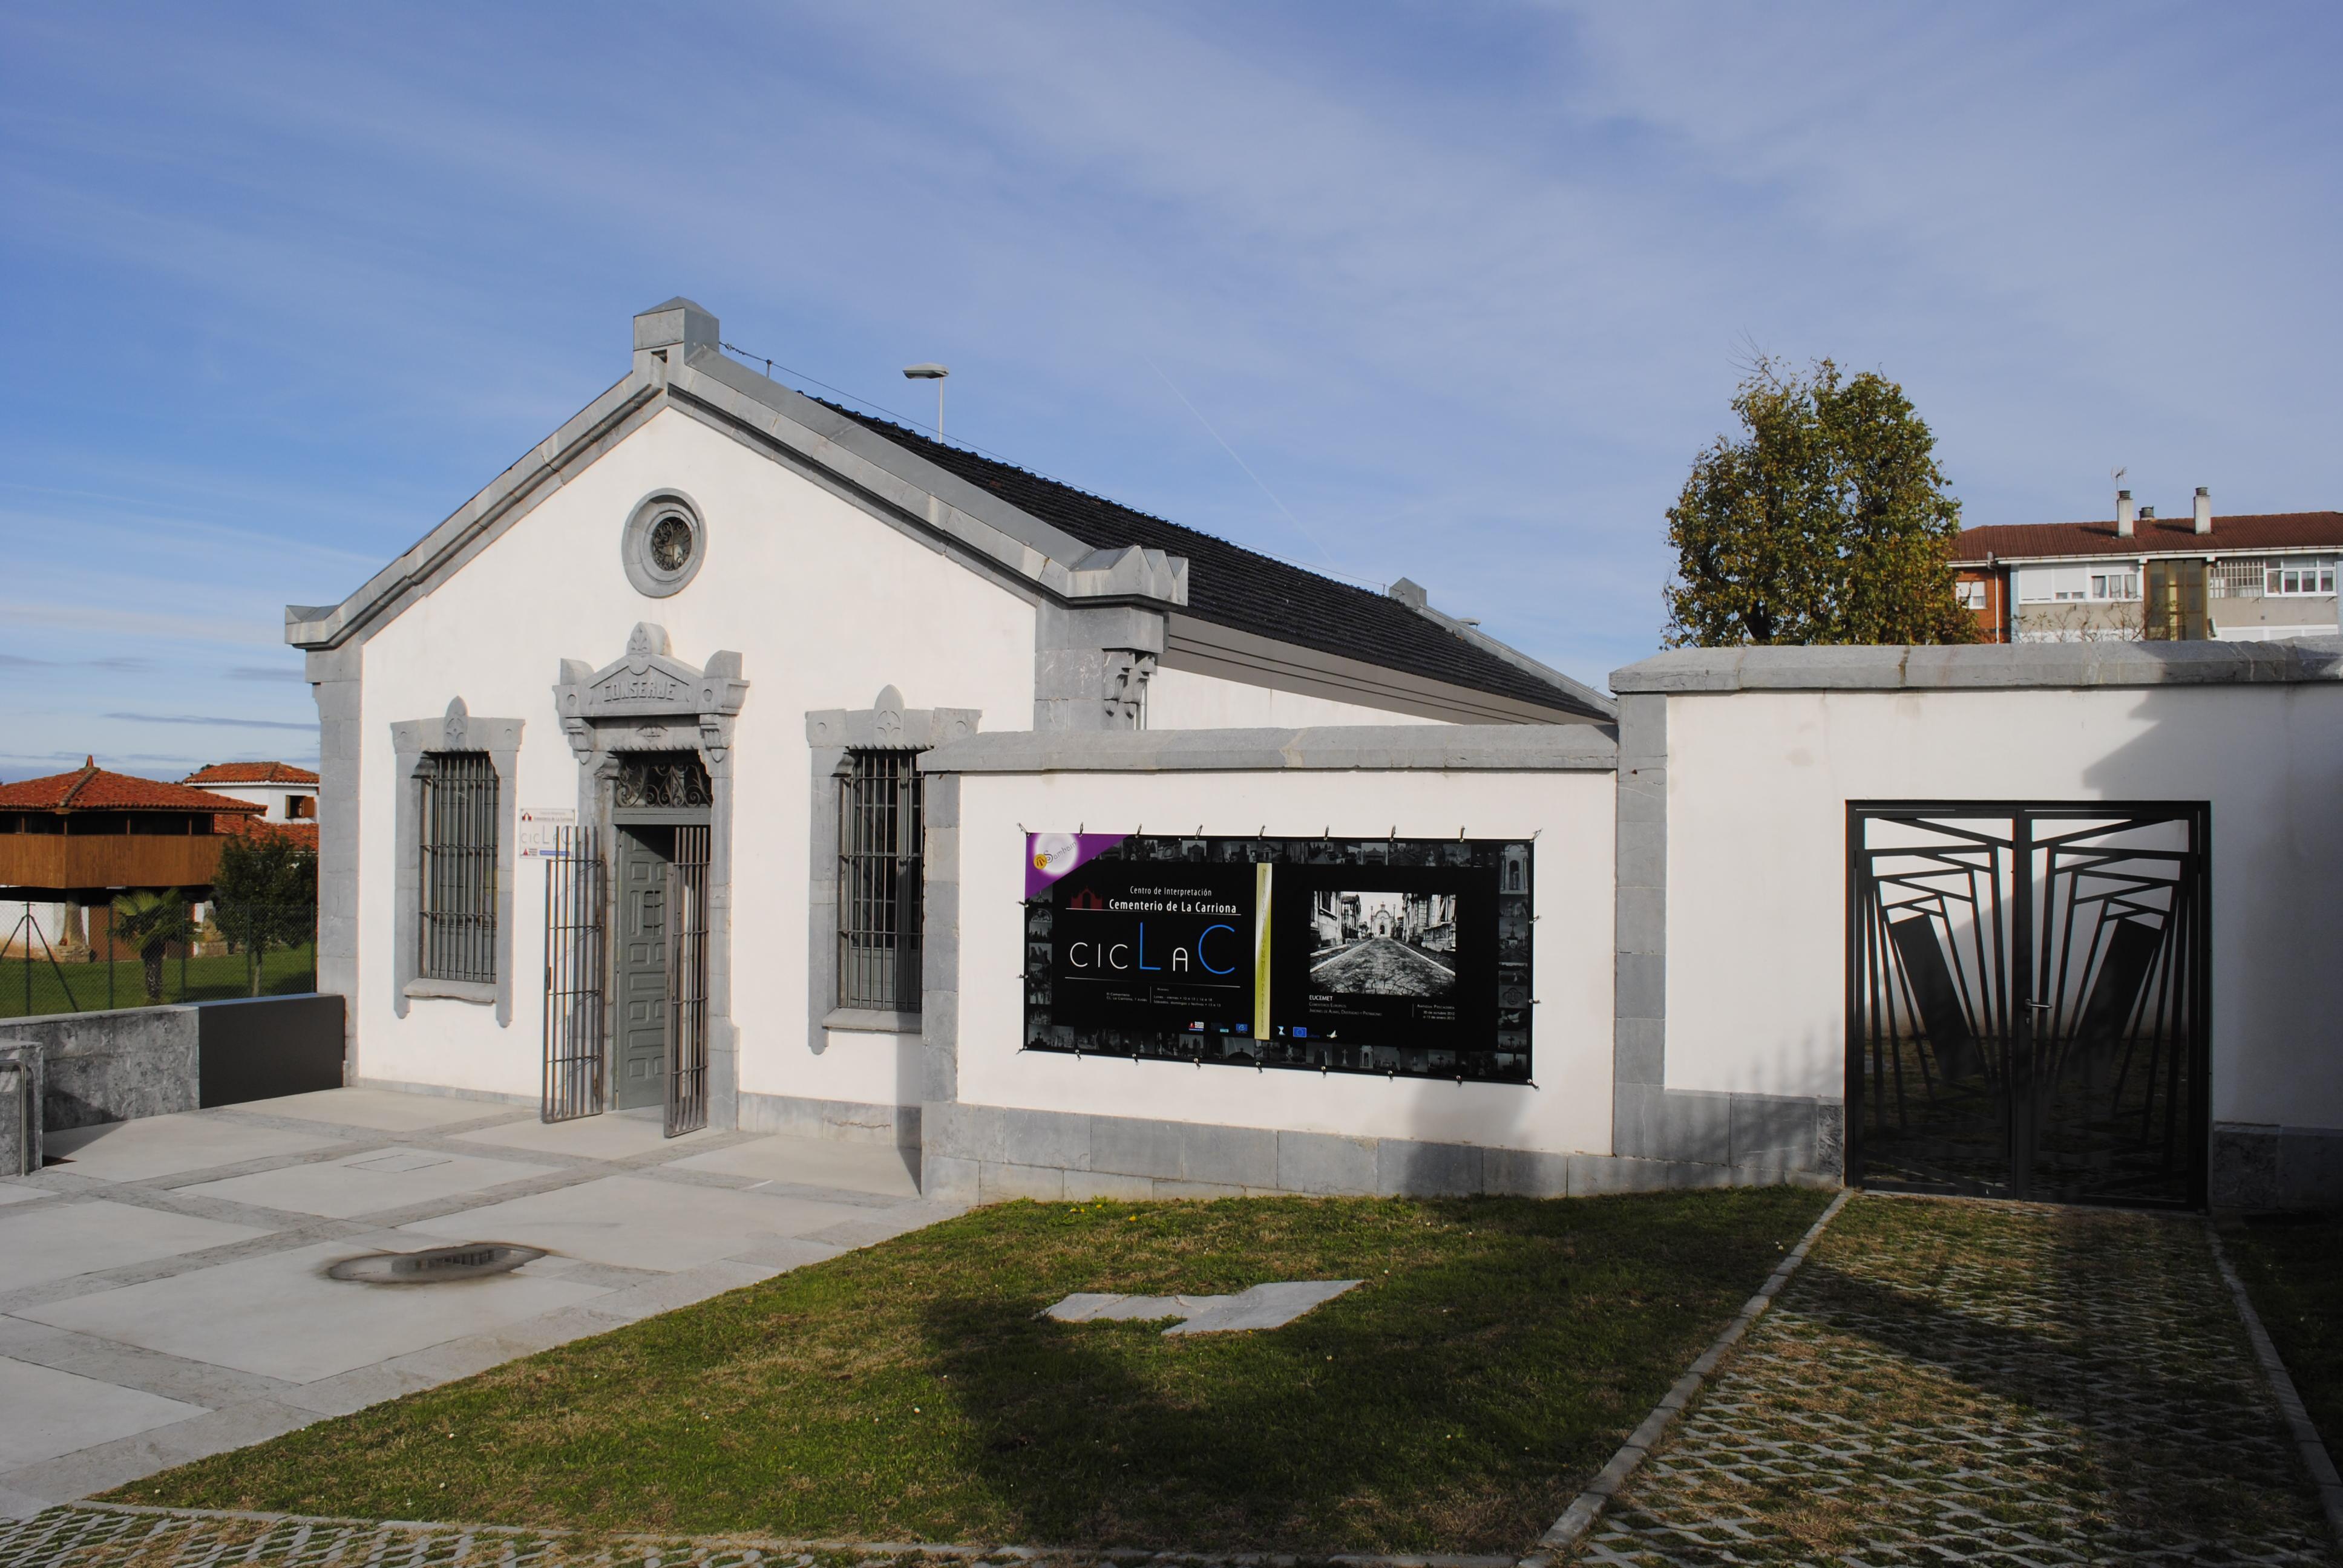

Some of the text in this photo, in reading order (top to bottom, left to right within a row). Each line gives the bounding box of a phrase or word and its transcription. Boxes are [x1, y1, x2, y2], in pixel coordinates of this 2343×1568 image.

[604, 681, 676, 702] CONSERJE
[1164, 887, 1212, 897] Interpretación
[1109, 899, 1236, 913] Cementerio de La Carriona
